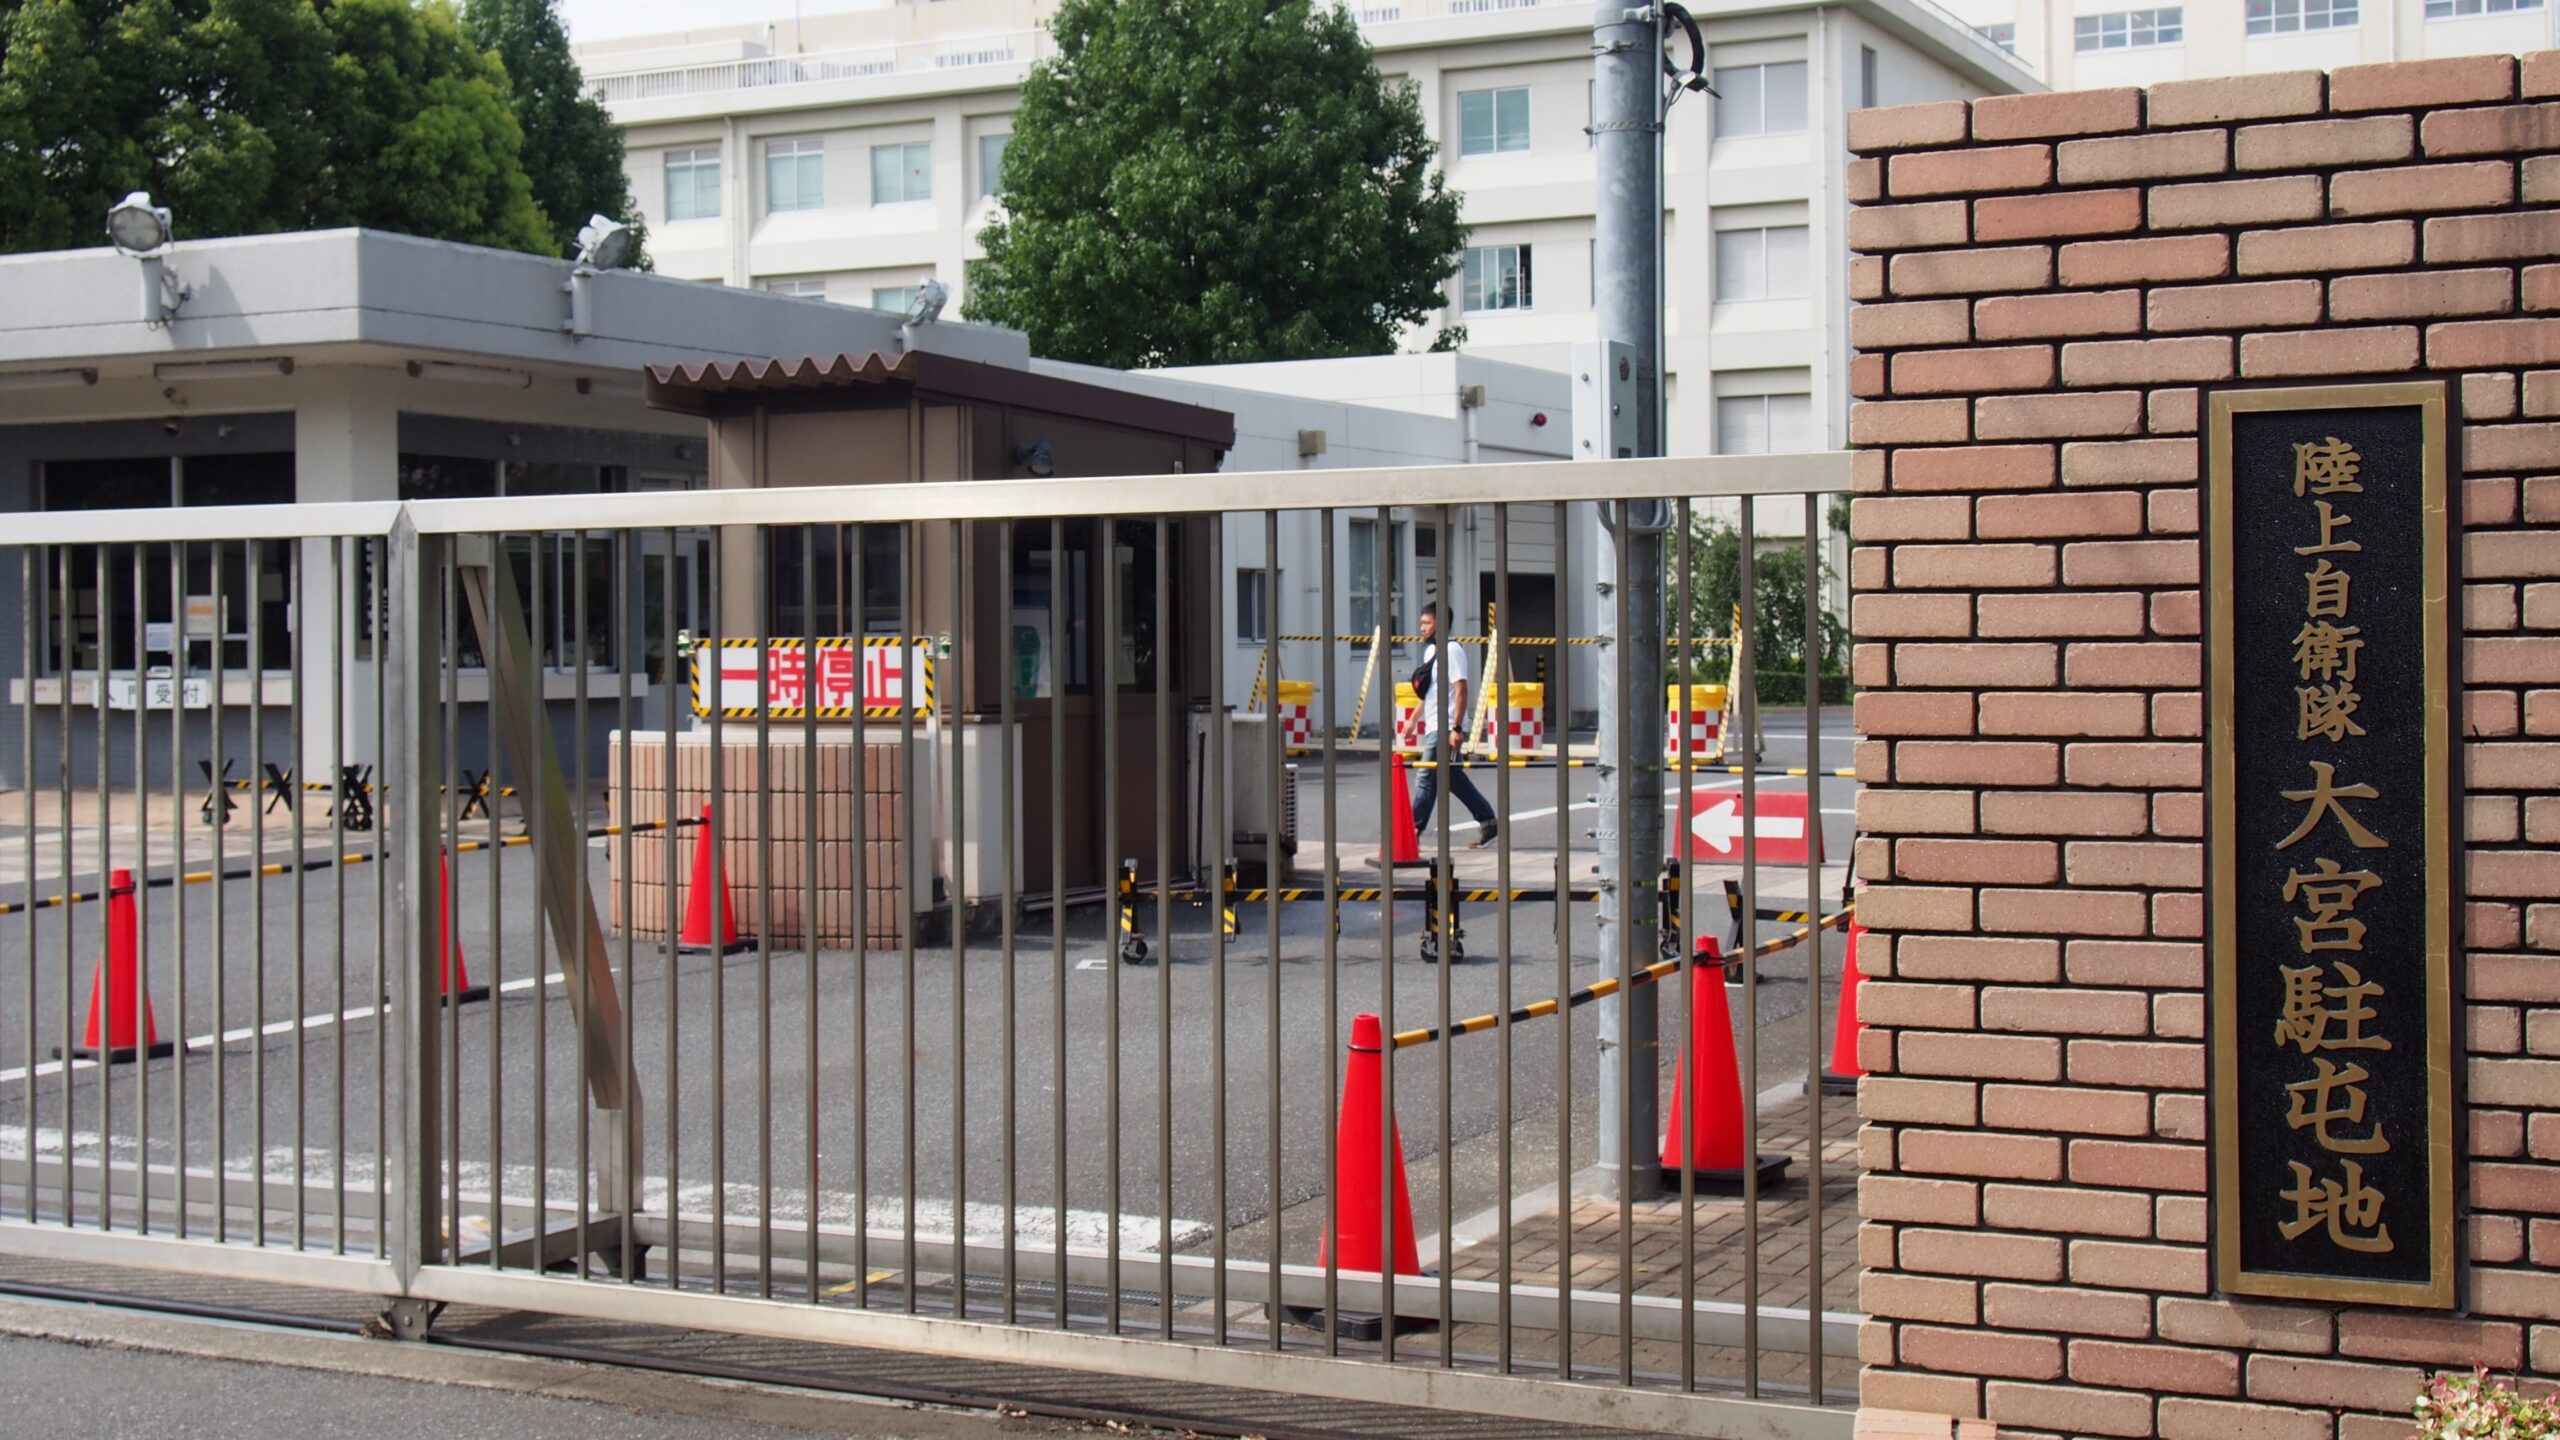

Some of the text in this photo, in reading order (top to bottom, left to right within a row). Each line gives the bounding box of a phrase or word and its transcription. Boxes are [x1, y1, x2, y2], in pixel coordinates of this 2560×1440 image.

[719, 648, 904, 707] 一時停止
[2275, 436, 2394, 1253] 陸上自衛隊大宮駐屯地
